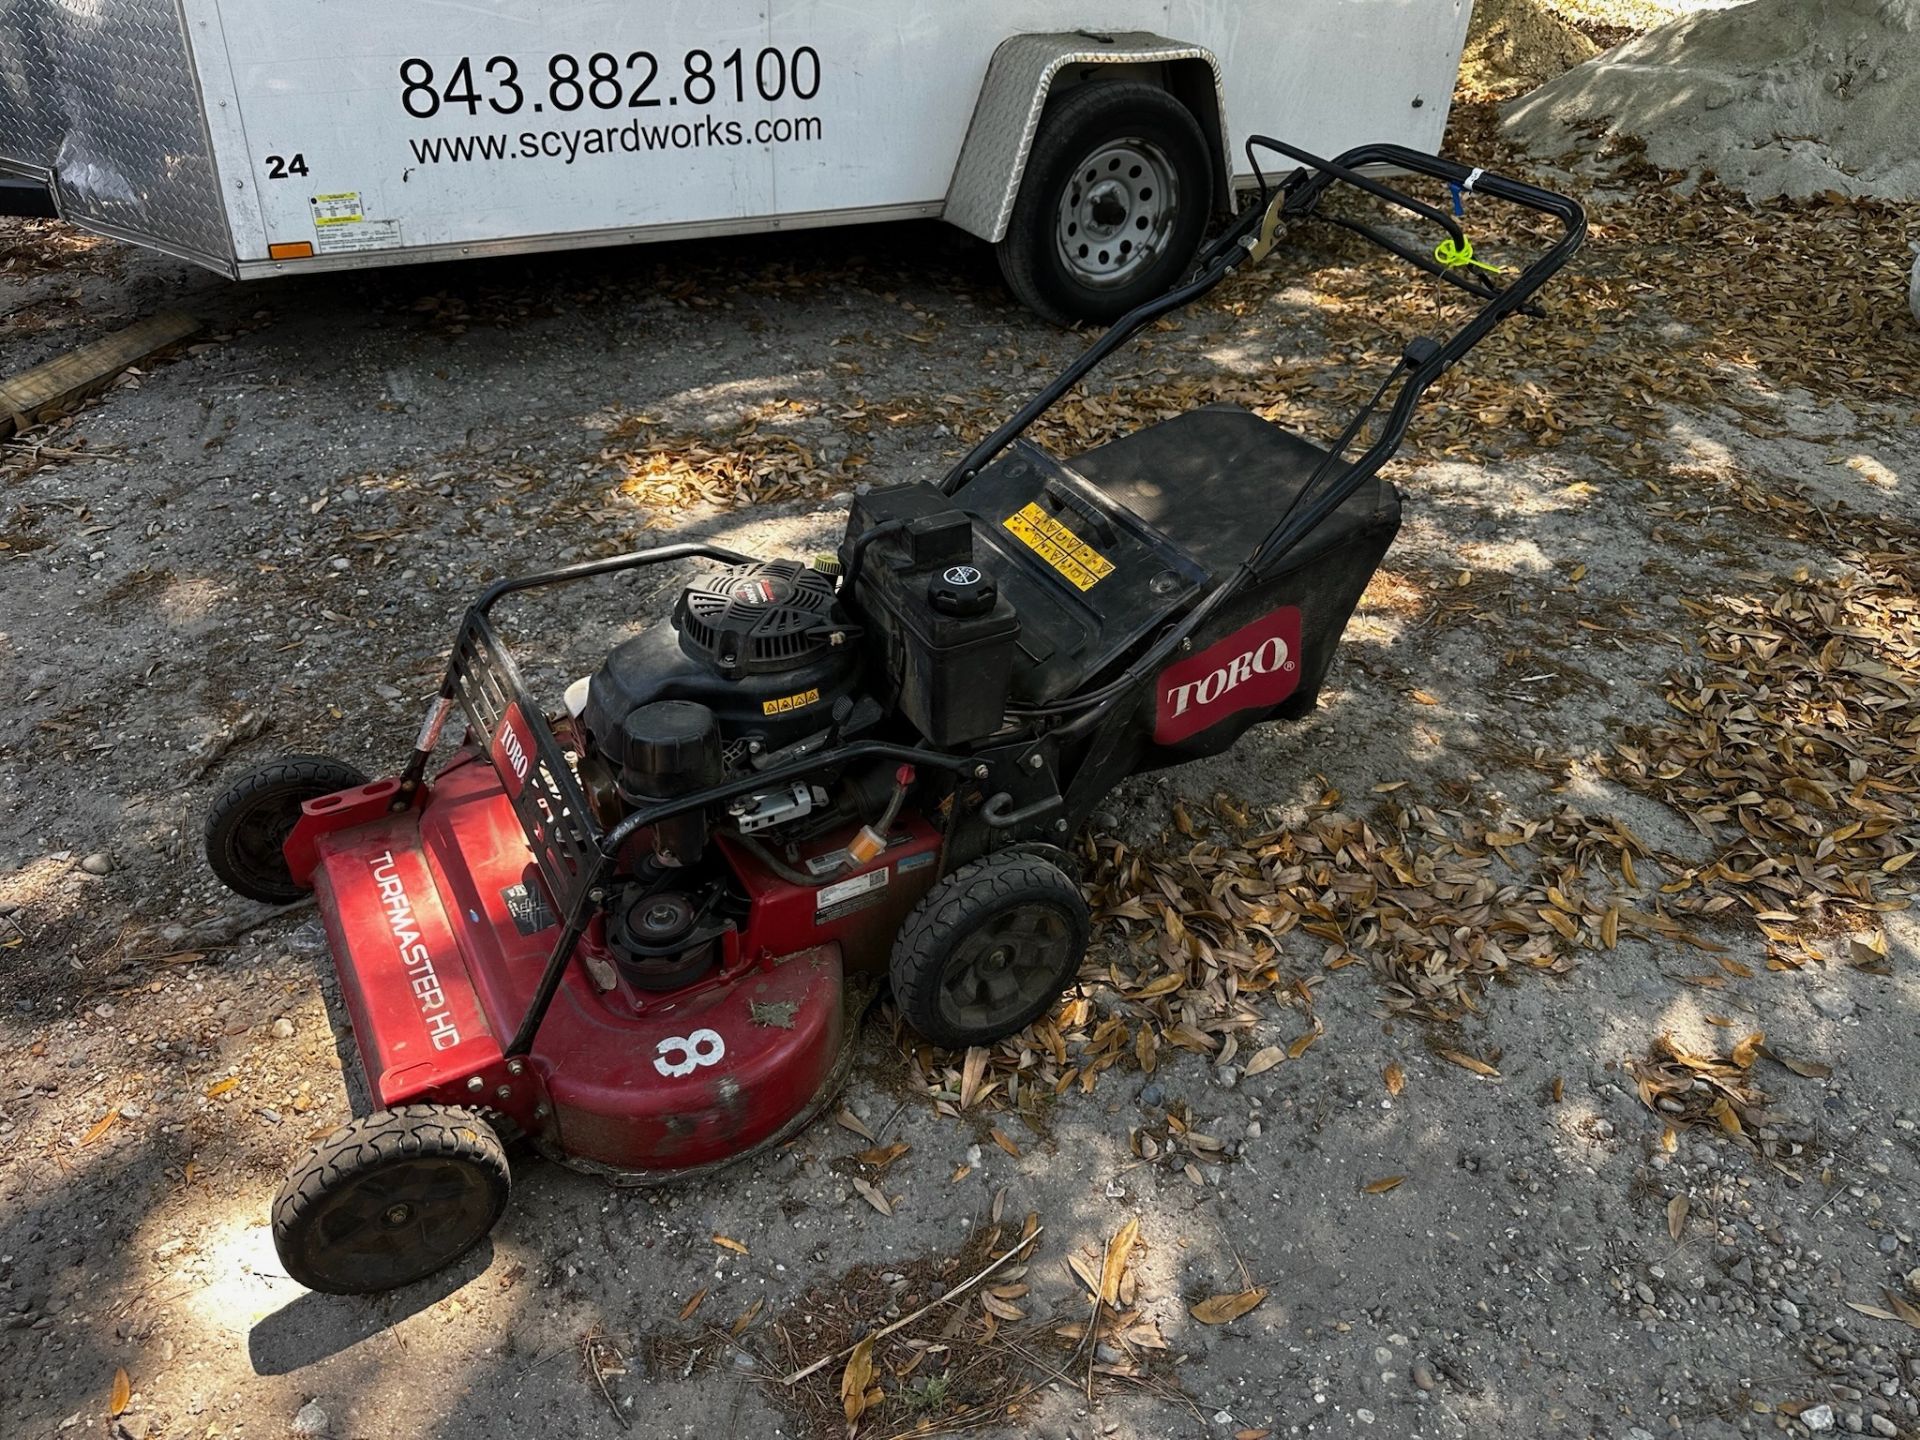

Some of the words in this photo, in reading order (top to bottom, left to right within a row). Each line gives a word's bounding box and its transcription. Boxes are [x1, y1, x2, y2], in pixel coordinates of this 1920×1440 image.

[400, 46, 821, 119] 843.882.8100
[265, 153, 309, 179] 24
[409, 114, 822, 165] www.scyardworks.com
[500, 720, 528, 780] TORO
[370, 851, 446, 1013] TURFMASTER
[426, 1012, 461, 1051] HD
[653, 1029, 725, 1077] 8
